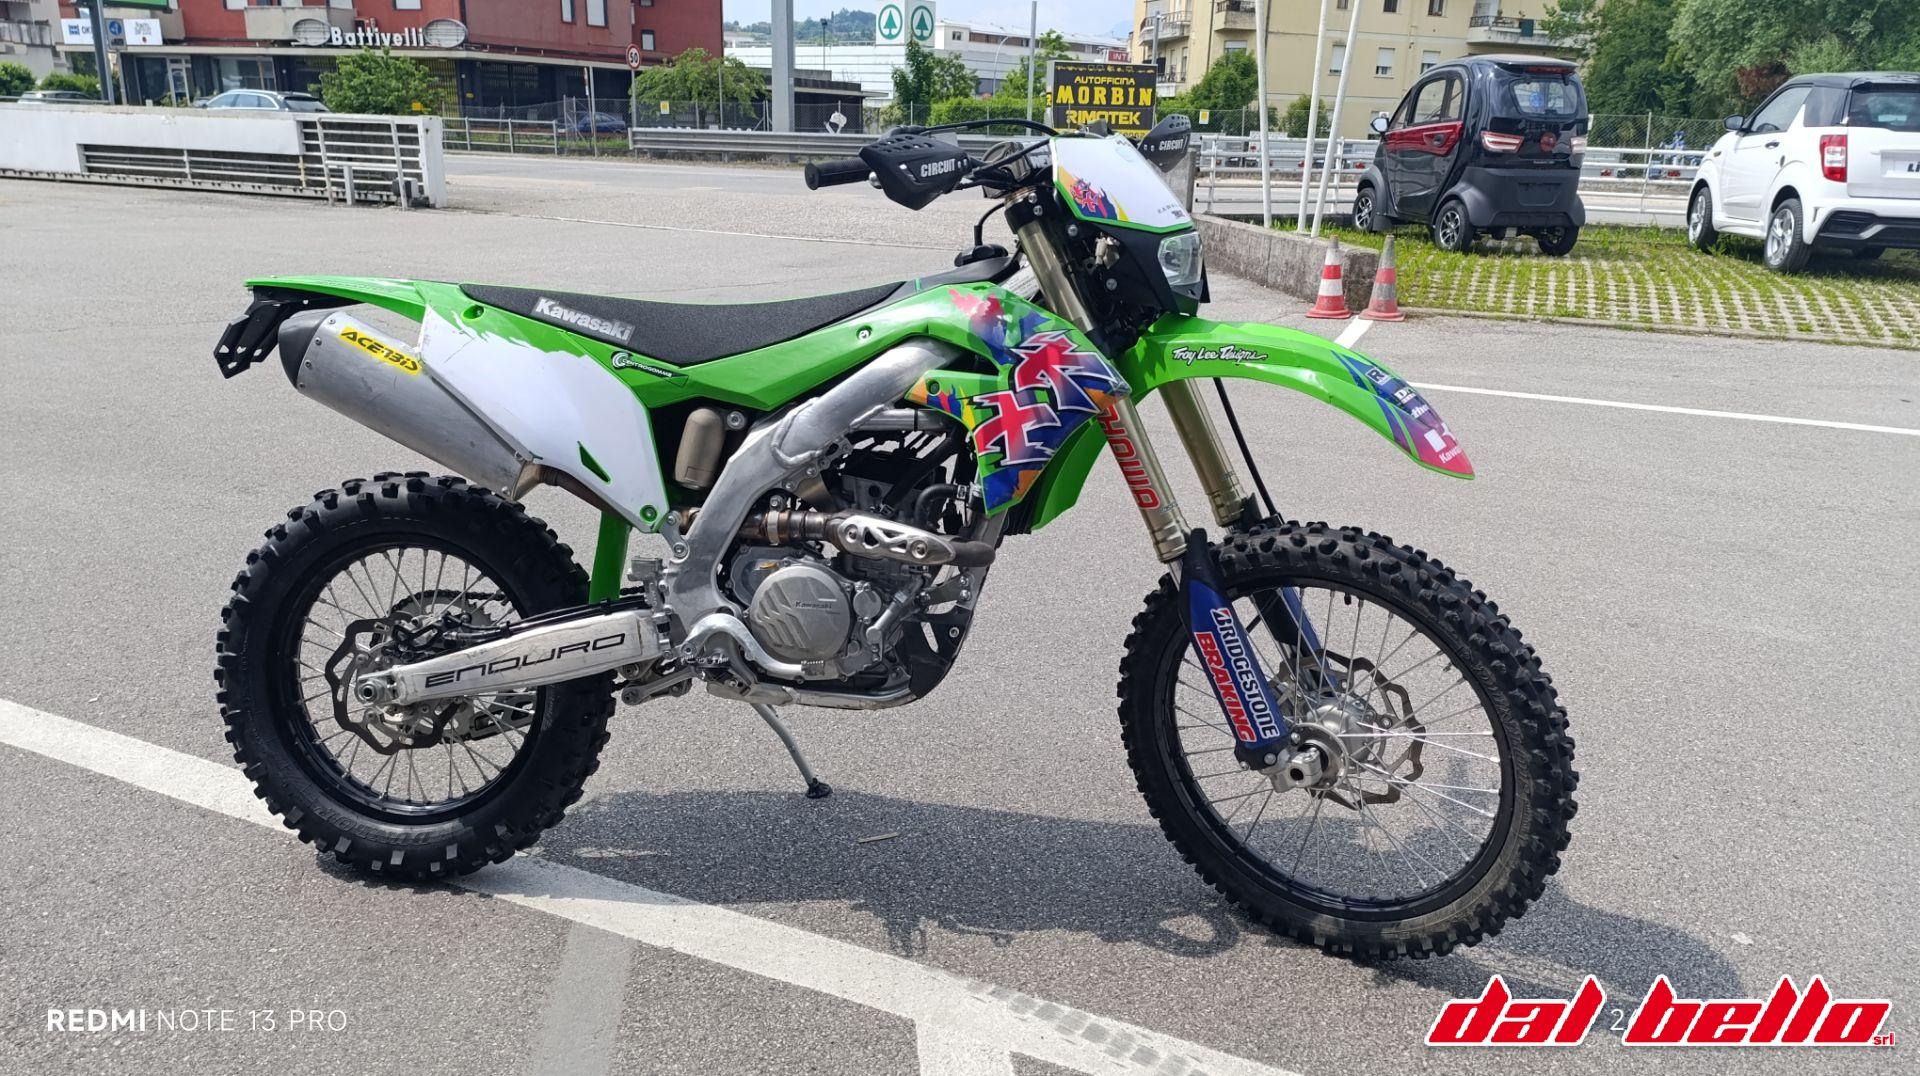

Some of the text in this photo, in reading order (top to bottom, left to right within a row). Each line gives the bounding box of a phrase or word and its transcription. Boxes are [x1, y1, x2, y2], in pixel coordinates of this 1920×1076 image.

[331, 27, 424, 46] Battivelli
[630, 51, 638, 63] 50
[1074, 75, 1135, 86] AUTOFFICINA
[1056, 85, 1152, 106] MORBIN
[1066, 110, 1141, 125] RIMOTEK
[1159, 138, 1184, 151] CIRCUIT
[920, 158, 956, 178] CIRCUIT
[535, 298, 633, 341] Kawasaki
[341, 331, 418, 371] ACERBIS
[1173, 344, 1268, 365] Troy Lee Designs
[425, 632, 626, 688] ENDURO
[1210, 607, 1280, 739] BRIDGESTONE
[1194, 632, 1257, 742] BRAKING
